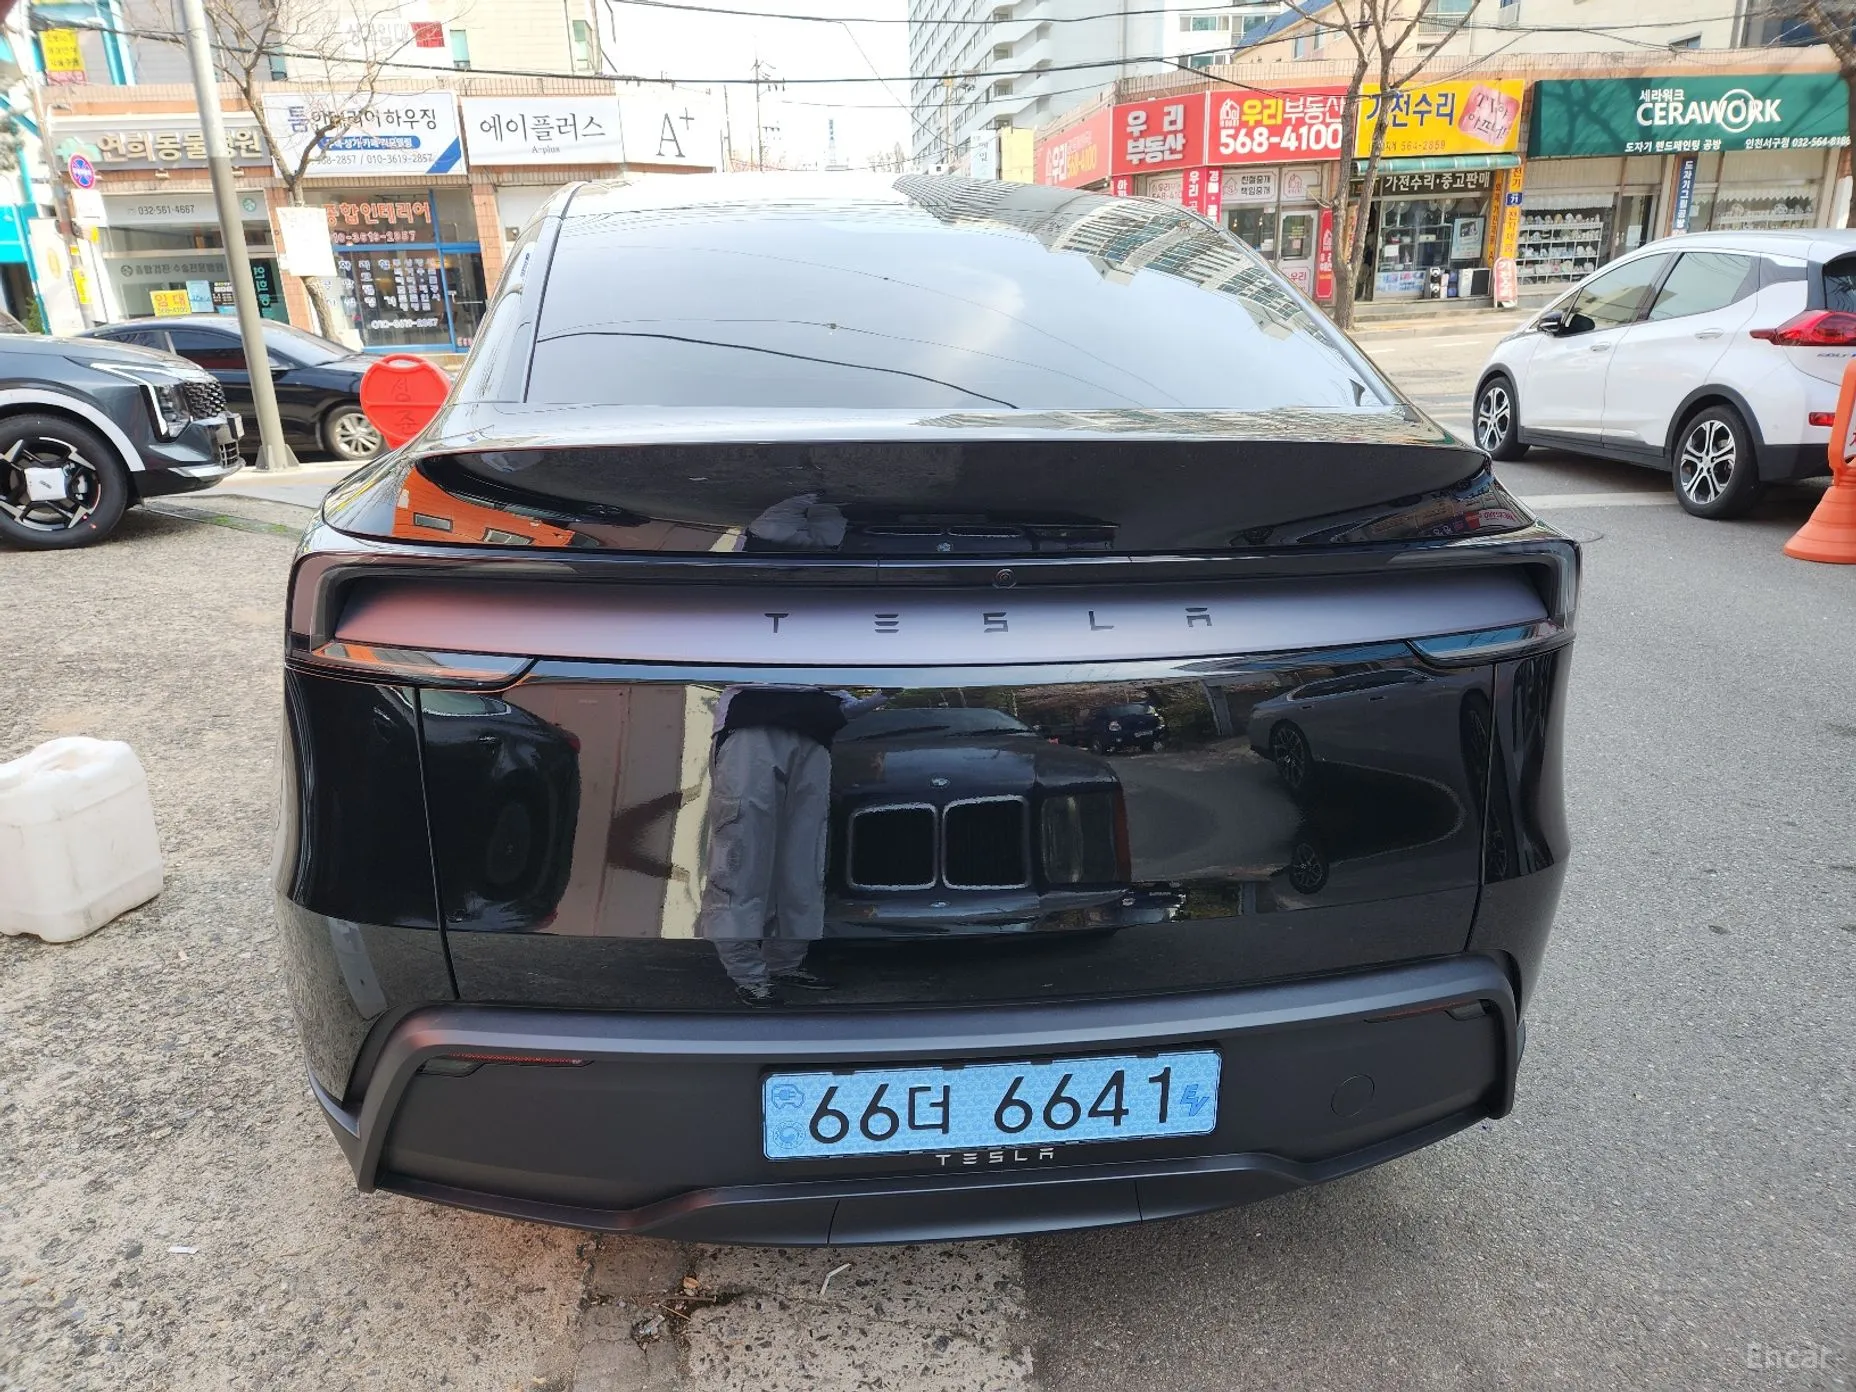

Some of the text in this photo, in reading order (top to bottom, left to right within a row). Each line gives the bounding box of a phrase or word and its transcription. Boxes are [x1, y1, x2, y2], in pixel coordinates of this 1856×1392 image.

[1639, 88, 1684, 102] 세라워크
[1126, 104, 1184, 134] 우리
[1636, 97, 1782, 127] CERAWORK
[479, 112, 606, 143] 에이플러스
[1219, 123, 1343, 155] 568-4100
[1125, 134, 1186, 164] 부동산
[1624, 141, 1653, 152] 도자기
[1703, 138, 1721, 151] 공방
[323, 201, 432, 227] 종합인테리어
[763, 606, 1214, 635] TESLA
[808, 1066, 1173, 1145] 66더 6641
[934, 1147, 1055, 1166] TESLA
